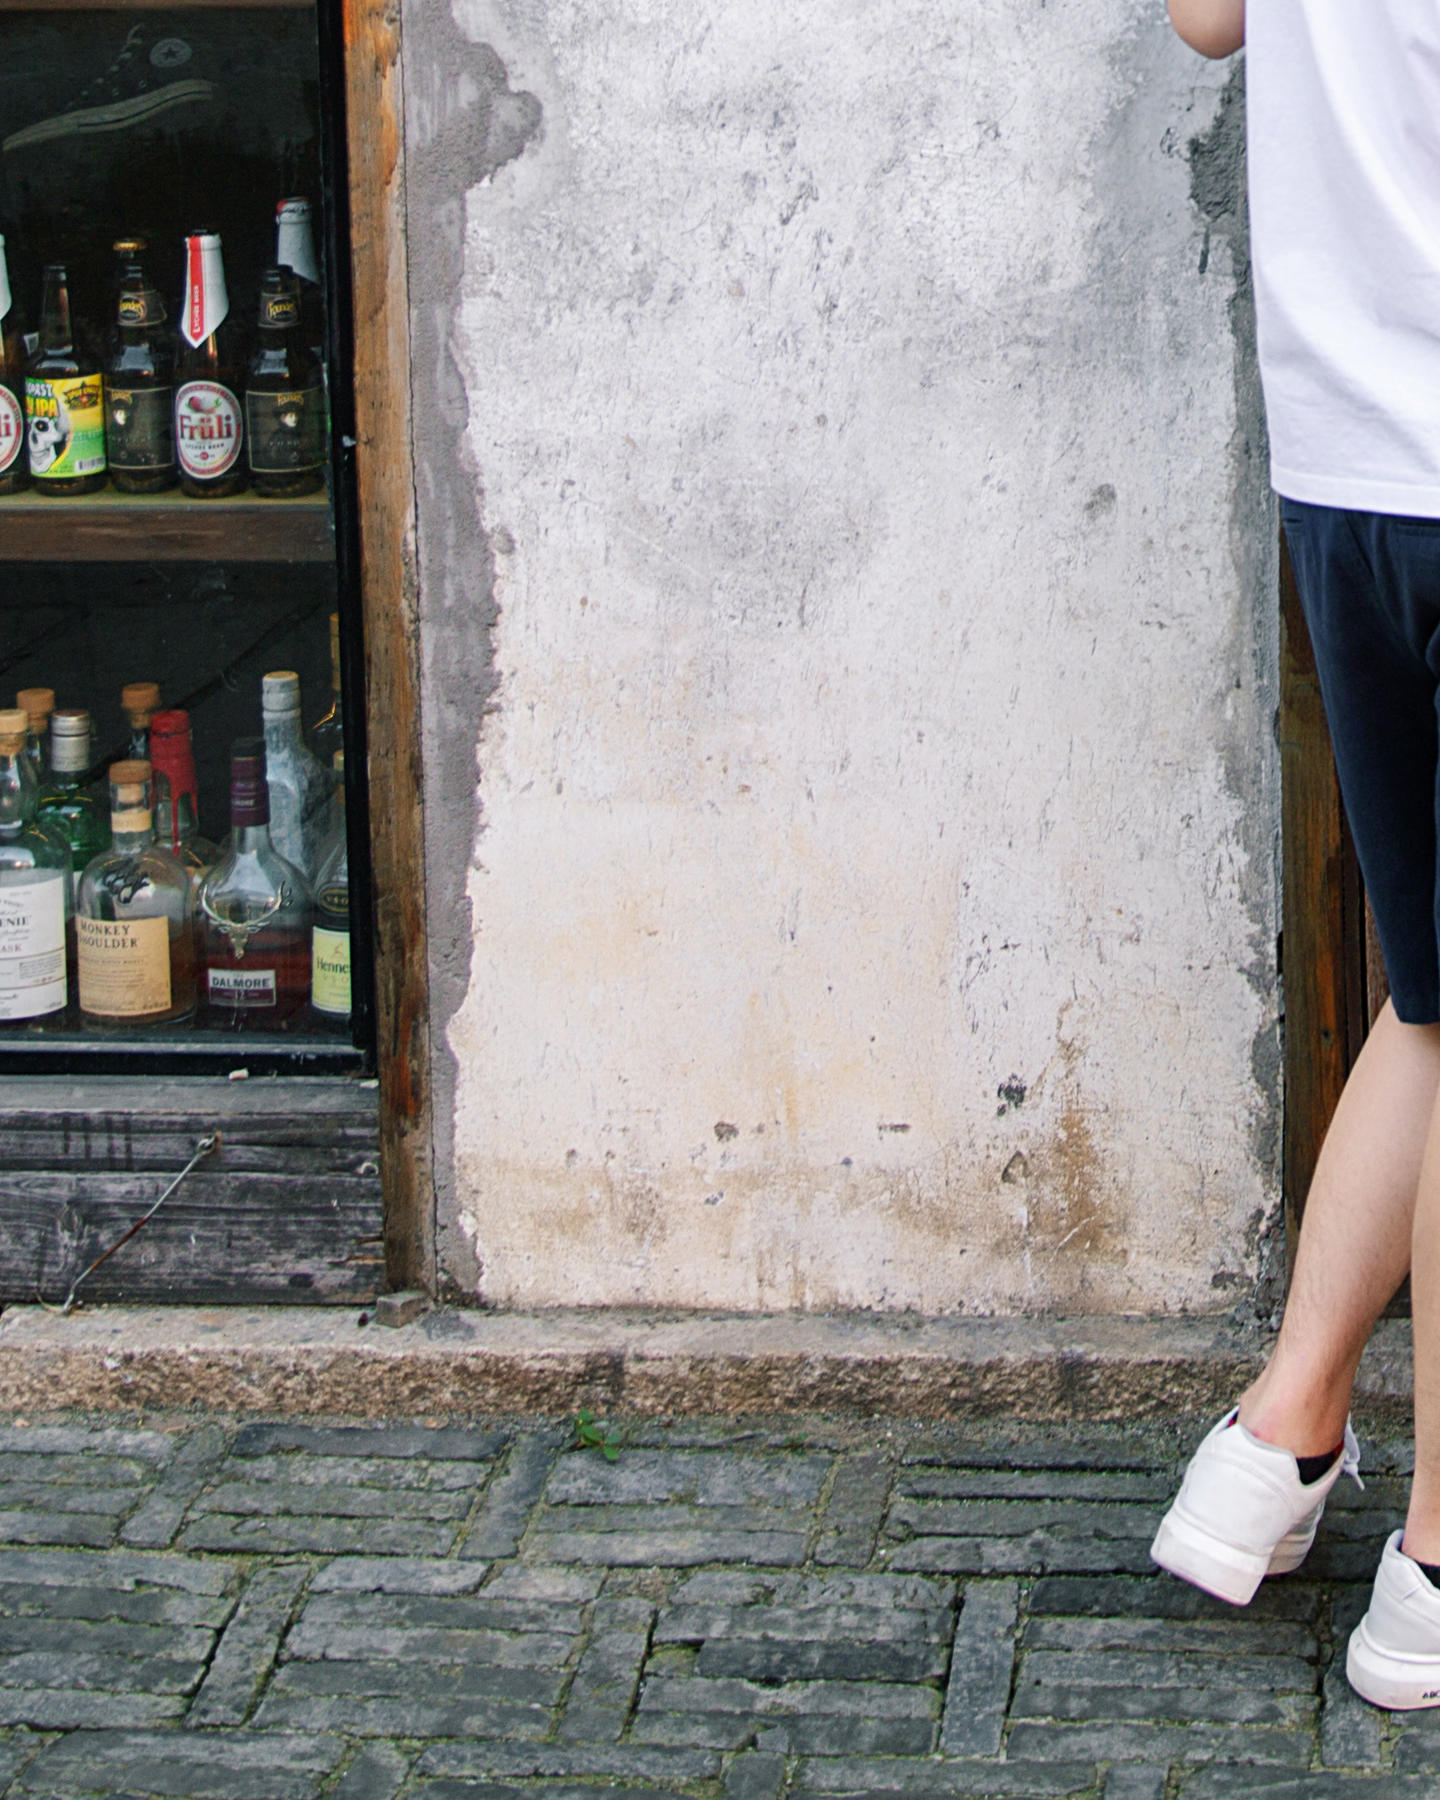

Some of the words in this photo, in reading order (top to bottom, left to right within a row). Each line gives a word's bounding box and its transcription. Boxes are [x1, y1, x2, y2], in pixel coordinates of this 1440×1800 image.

[180, 413, 232, 440] Früli
[81, 922, 130, 936] MONKEY
[79, 935, 138, 949] SHOULDER
[317, 957, 350, 973] Henne
[212, 976, 270, 988] DALMORE
